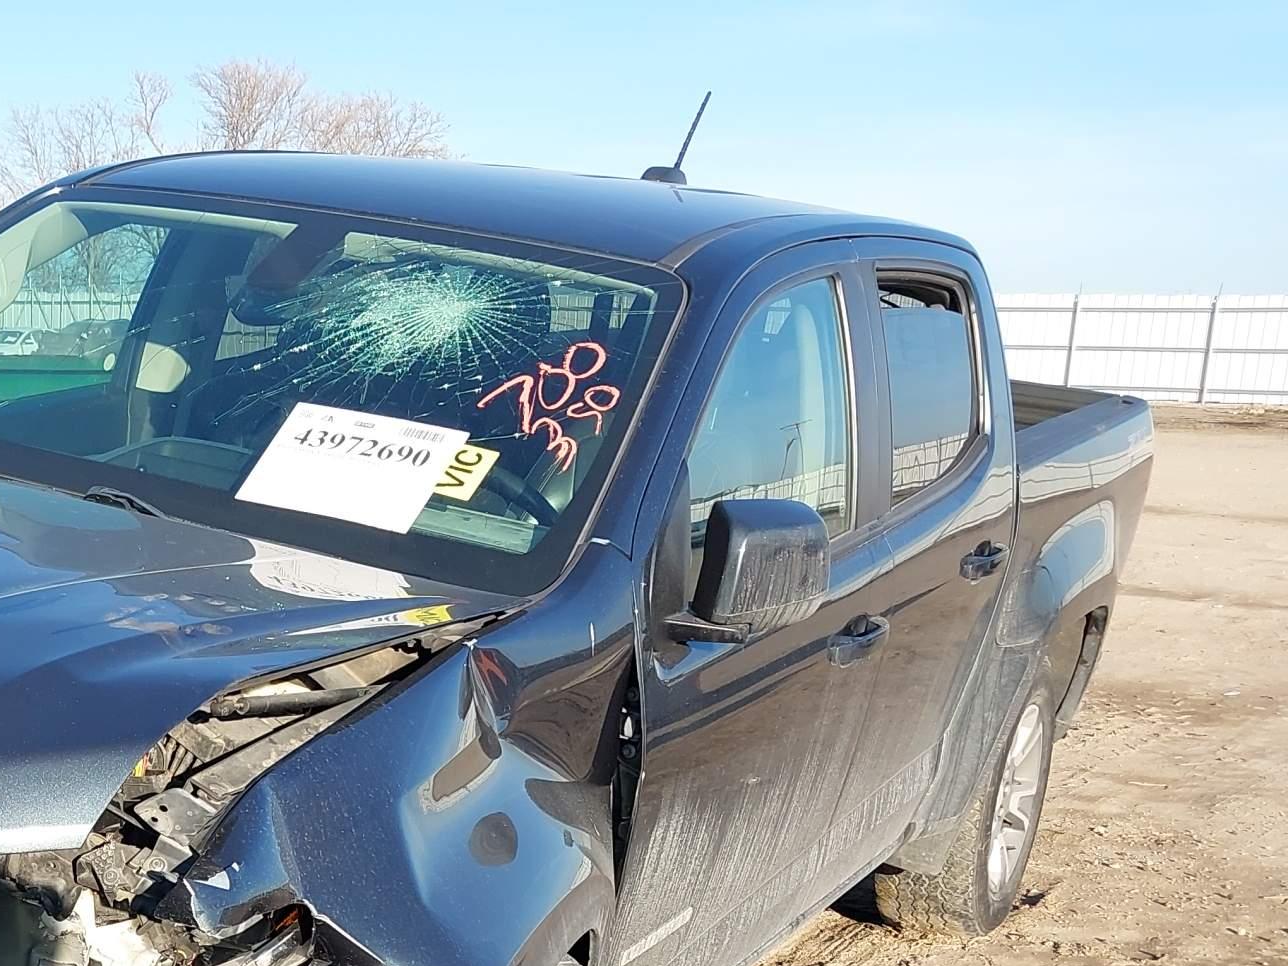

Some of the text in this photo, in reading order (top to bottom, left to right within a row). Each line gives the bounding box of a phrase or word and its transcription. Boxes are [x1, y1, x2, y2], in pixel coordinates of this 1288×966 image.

[476, 342, 607, 434] 700
[294, 428, 431, 468] 43972690
[435, 449, 484, 489] VIC
